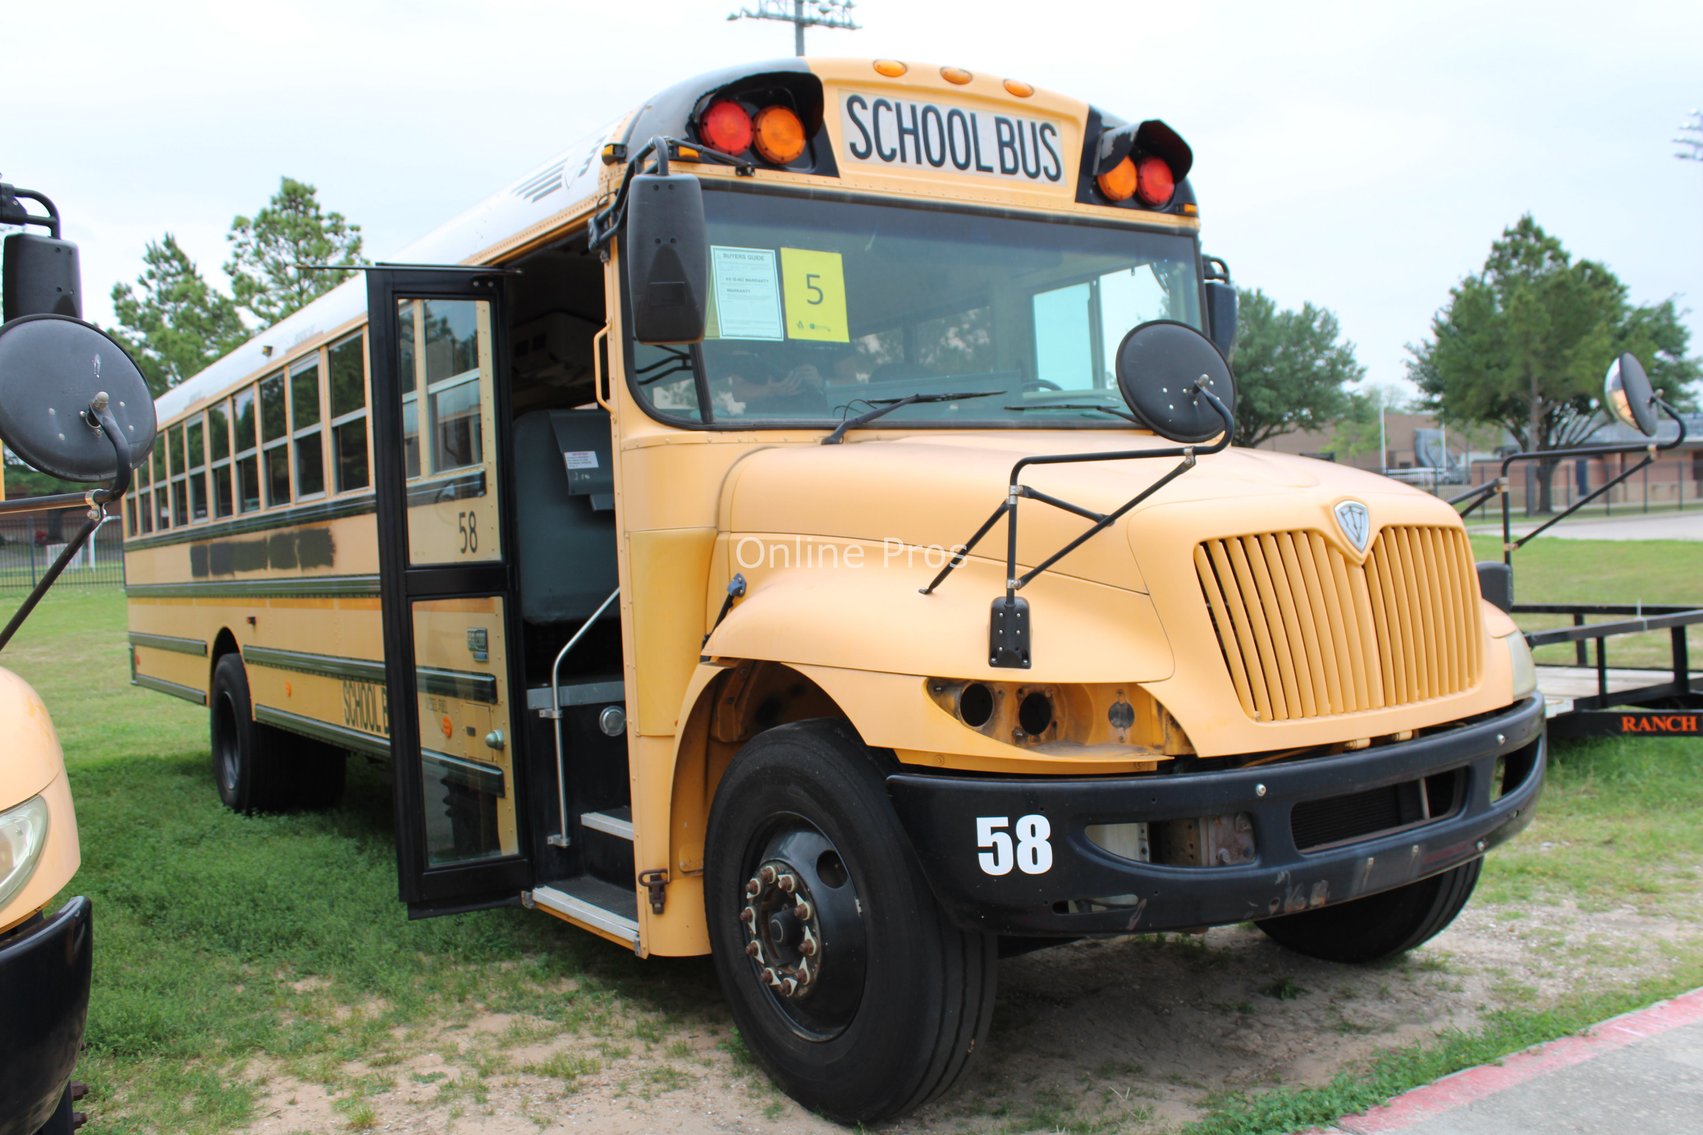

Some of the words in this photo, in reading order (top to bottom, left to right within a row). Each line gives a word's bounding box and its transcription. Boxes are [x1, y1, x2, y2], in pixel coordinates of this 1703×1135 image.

[846, 94, 994, 173] SCHOOL
[994, 116, 1062, 182] BUS
[806, 273, 824, 305] 5
[459, 511, 478, 554] 58
[343, 680, 382, 732] SCHOOL
[1621, 715, 1698, 732] RANCH
[976, 814, 1053, 876] 58
